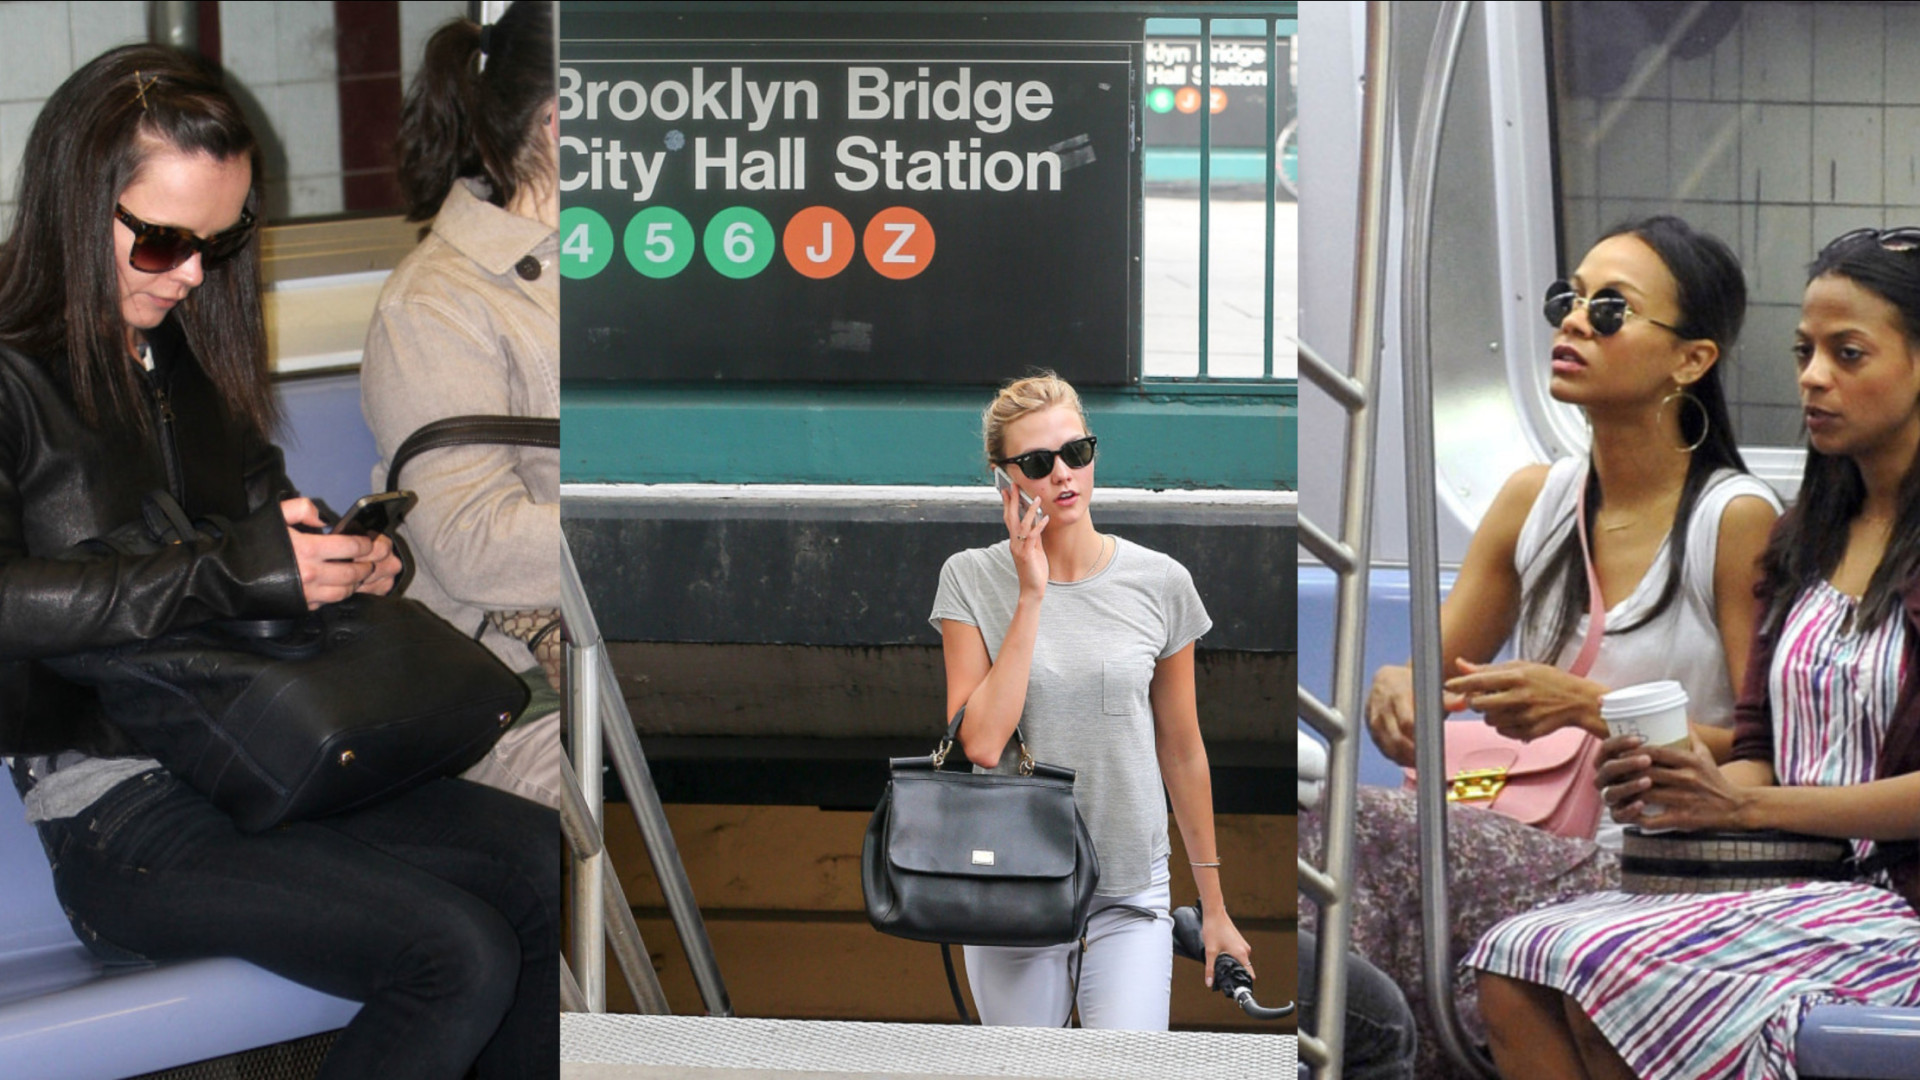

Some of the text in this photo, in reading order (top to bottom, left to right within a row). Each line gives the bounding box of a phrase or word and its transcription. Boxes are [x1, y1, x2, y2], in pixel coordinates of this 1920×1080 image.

[560, 67, 1053, 132] Brooklyn Bridge
[1146, 64, 1187, 85] Hall
[560, 135, 1062, 201] City Hall Station
[562, 222, 916, 263] 4 5 6 J Z
